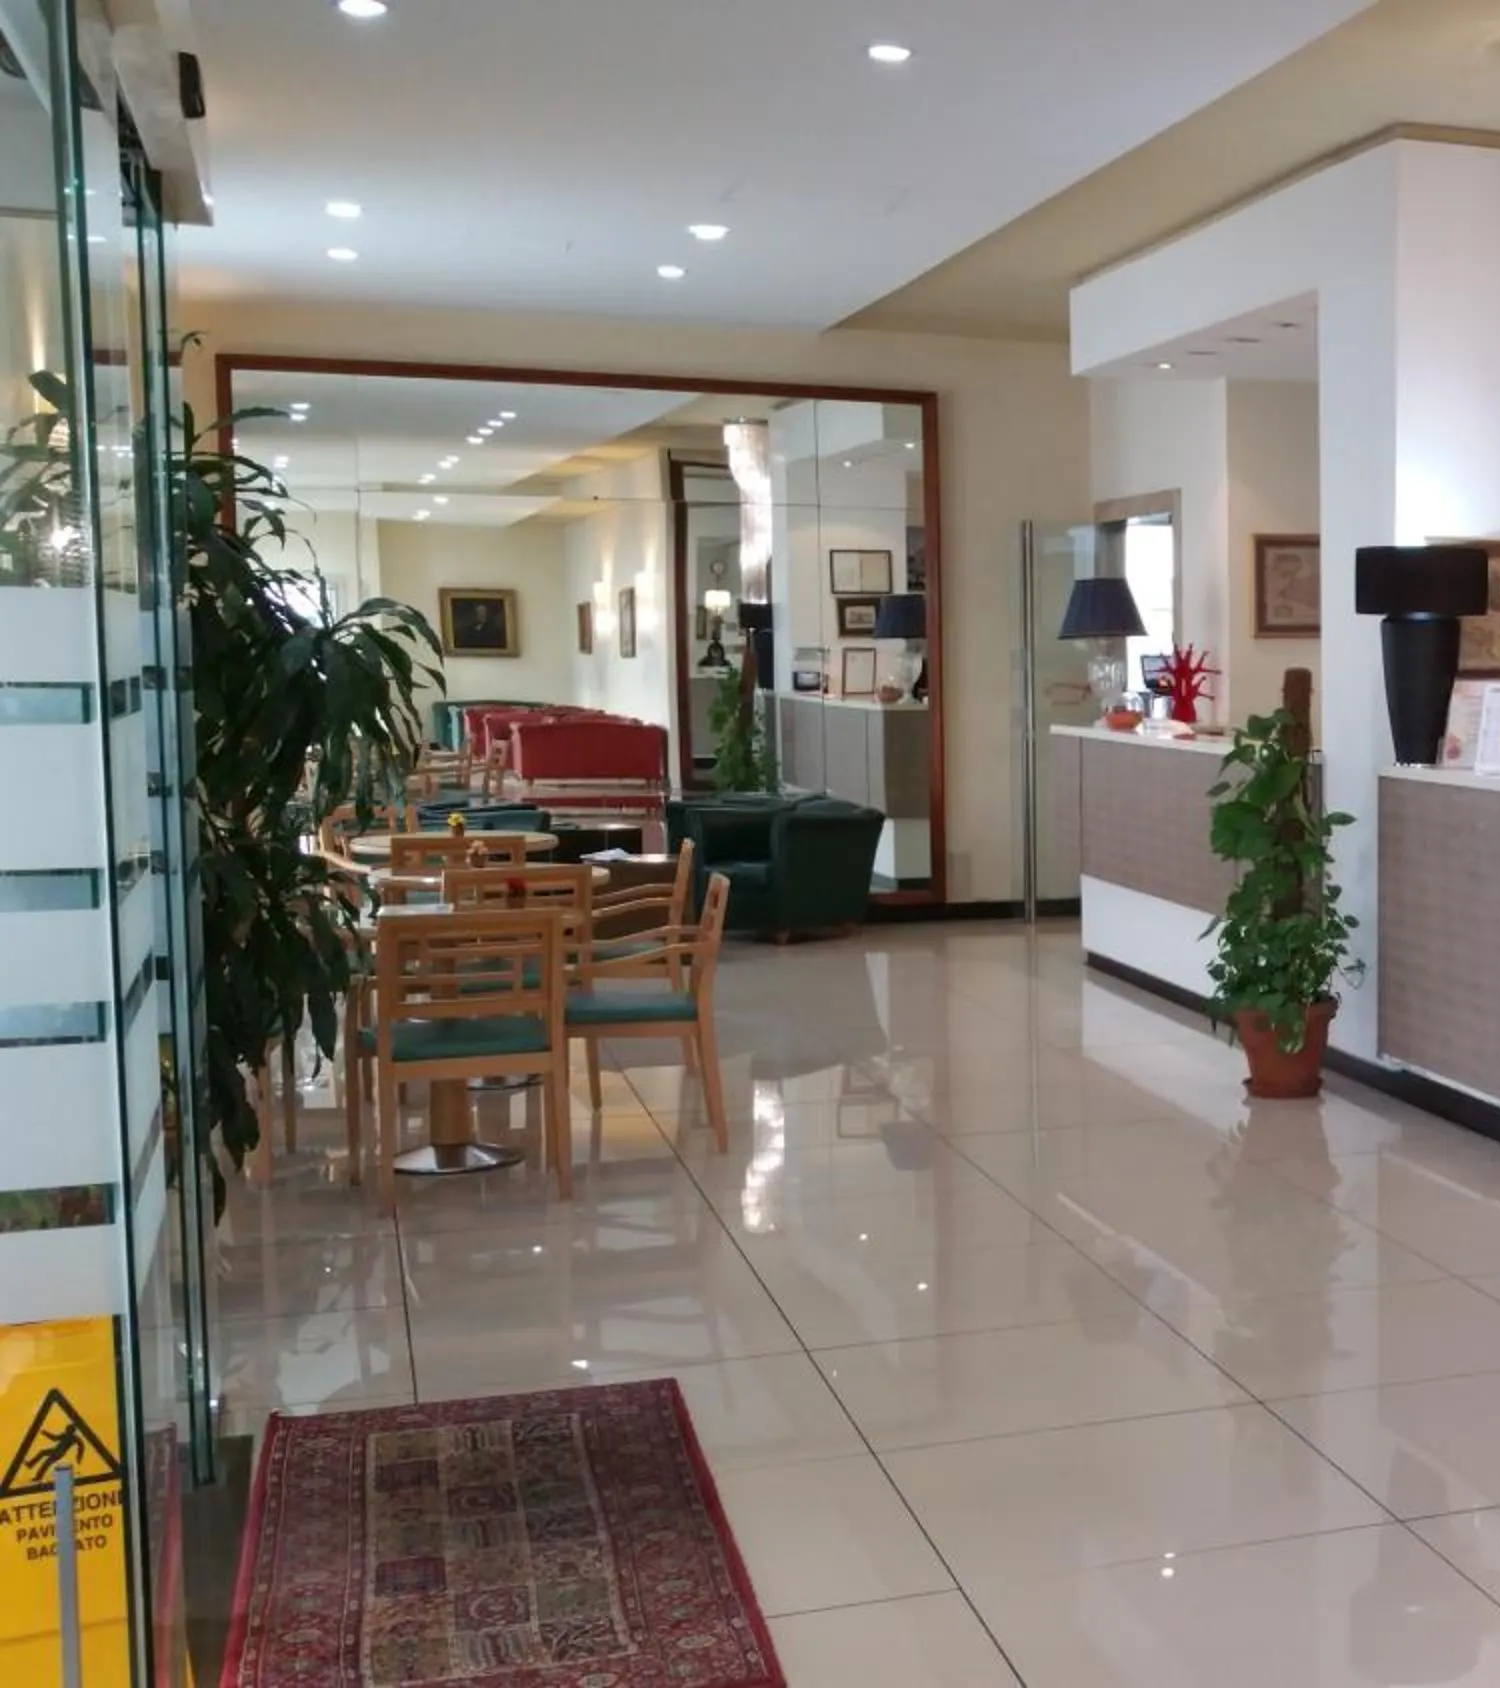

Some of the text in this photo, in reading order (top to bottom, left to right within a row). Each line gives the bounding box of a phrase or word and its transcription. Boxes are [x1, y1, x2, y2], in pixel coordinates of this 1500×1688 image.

[0, 1489, 124, 1525] ATTEION
[16, 1514, 113, 1543] PAVINTO
[27, 1535, 107, 1560] BAGATO
